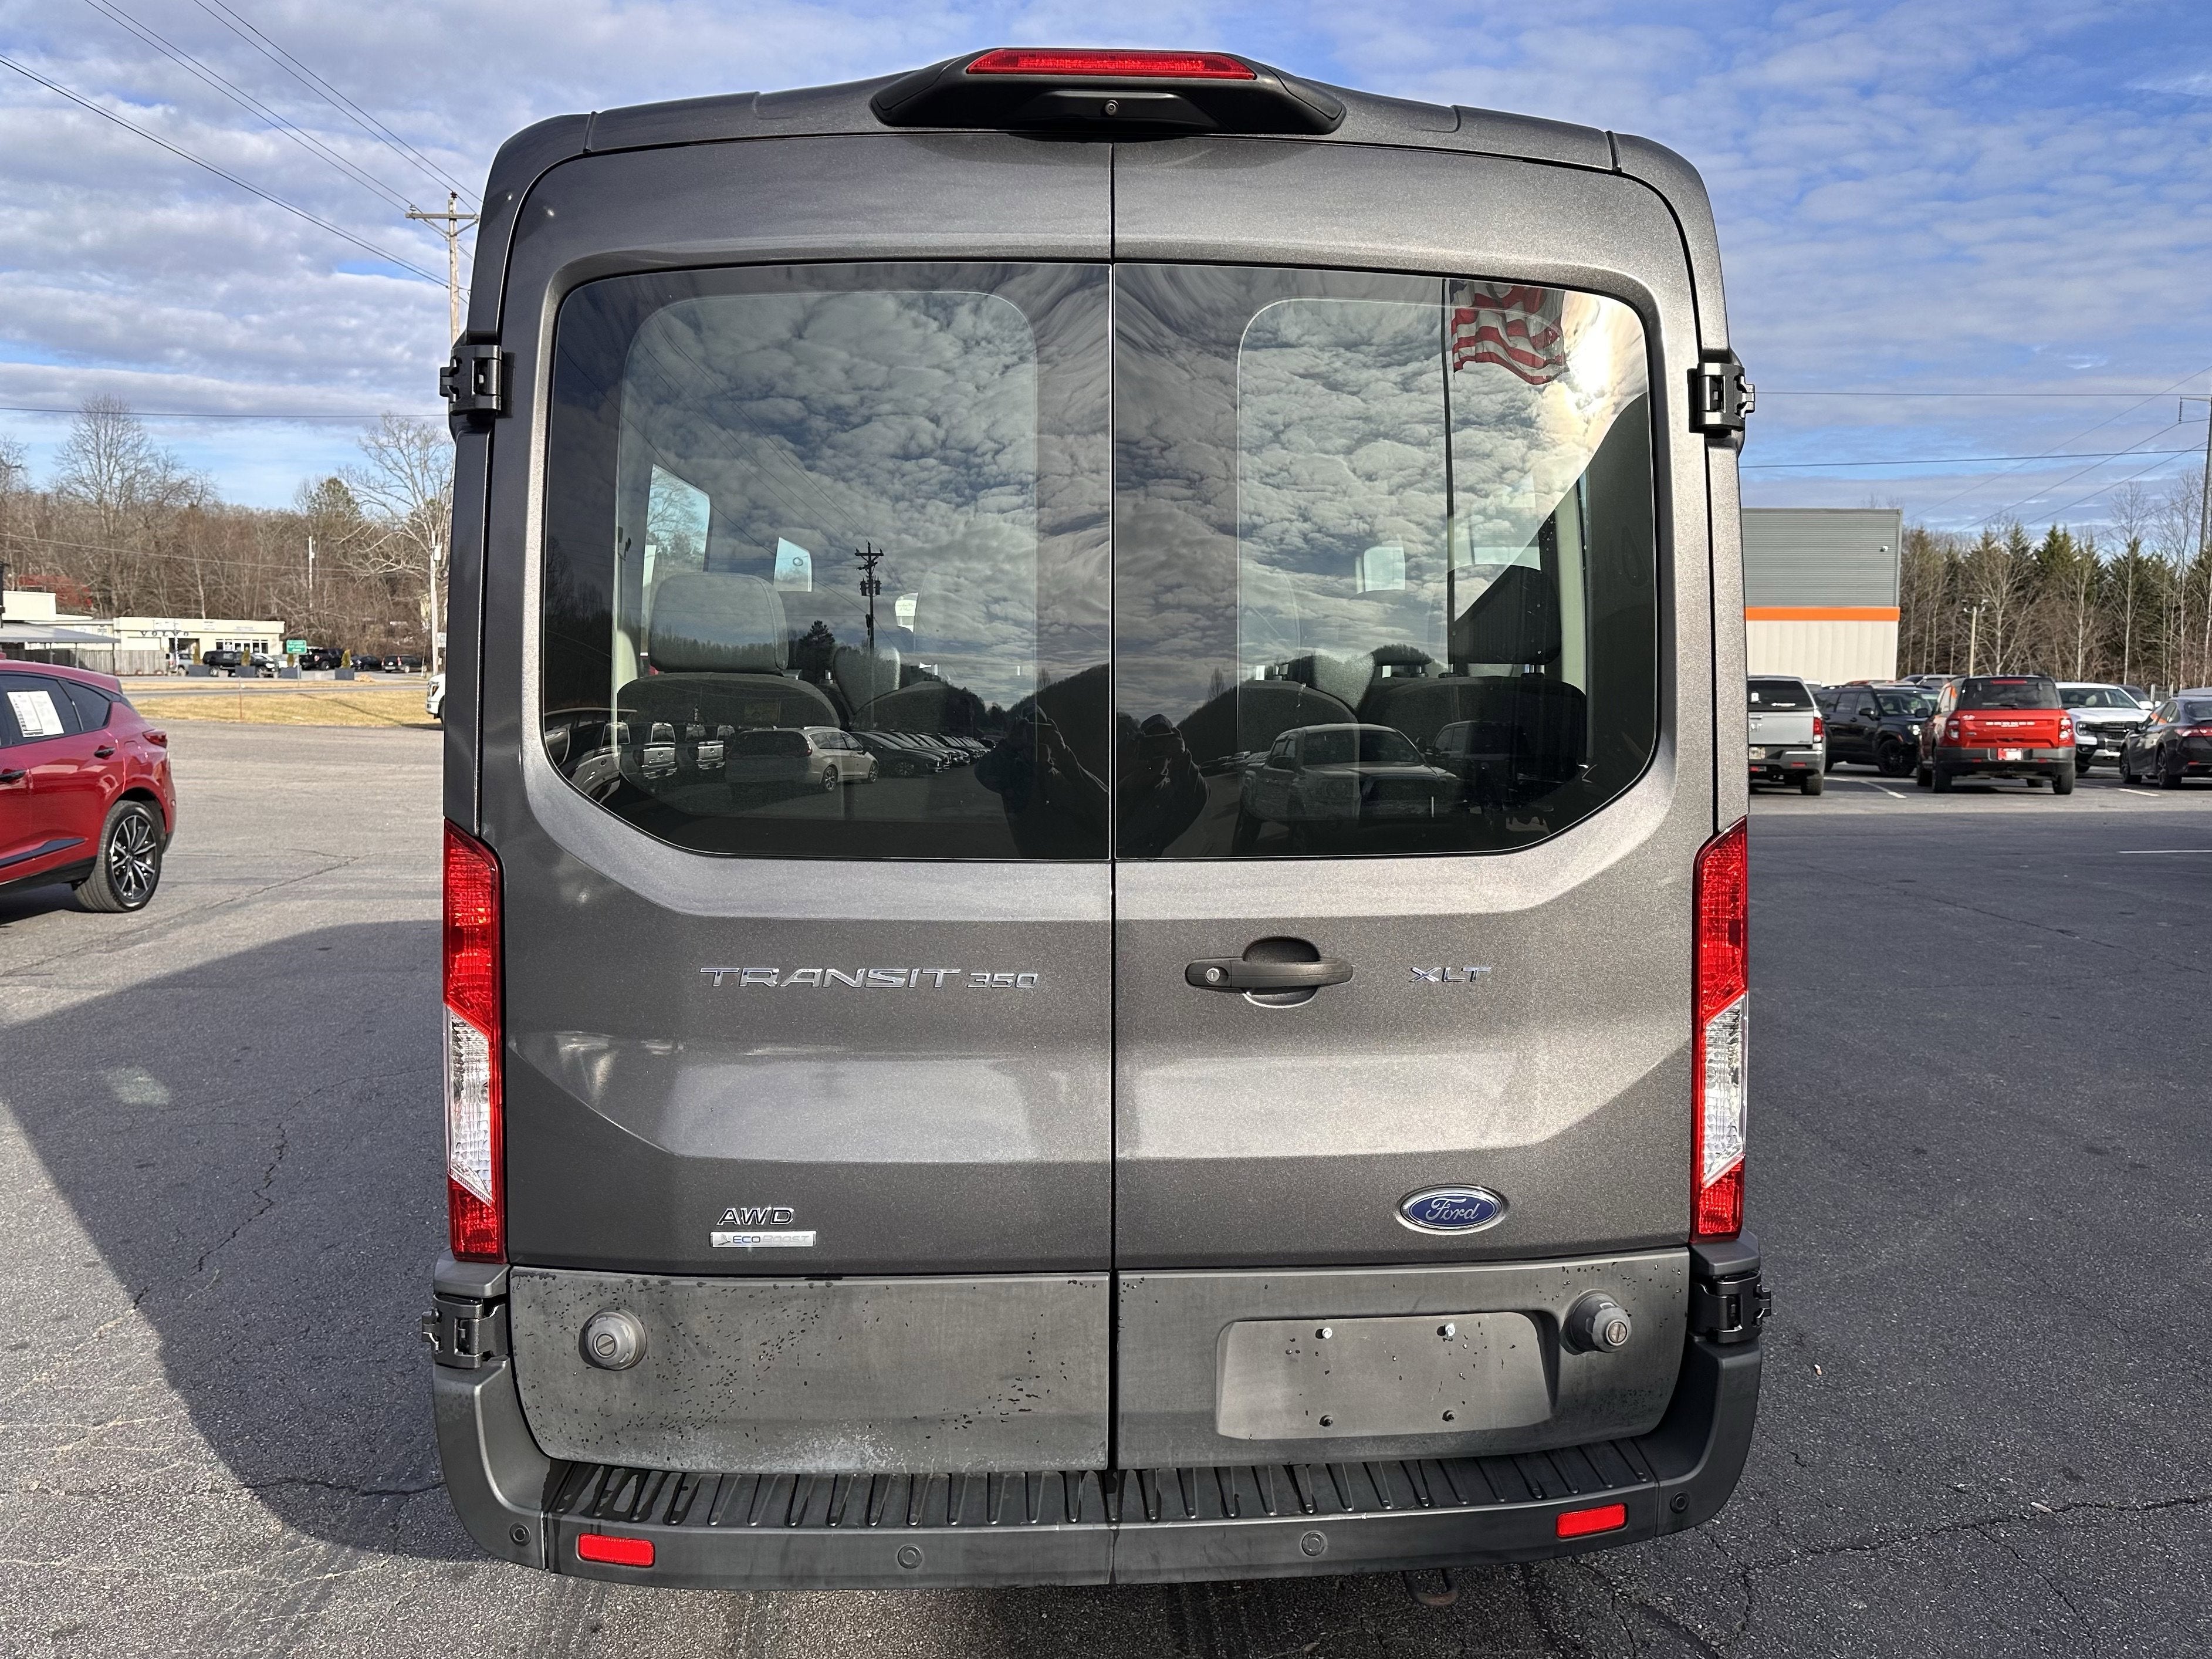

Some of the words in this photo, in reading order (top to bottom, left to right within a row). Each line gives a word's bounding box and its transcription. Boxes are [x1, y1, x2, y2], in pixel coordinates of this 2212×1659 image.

[699, 967, 961, 988] TRANSIT
[967, 972, 1039, 988] 350
[1409, 967, 1491, 982] XLT
[716, 1207, 794, 1225] AWD
[1425, 1198, 1480, 1221] Ford
[732, 1235, 810, 1244] ECOBOOST
